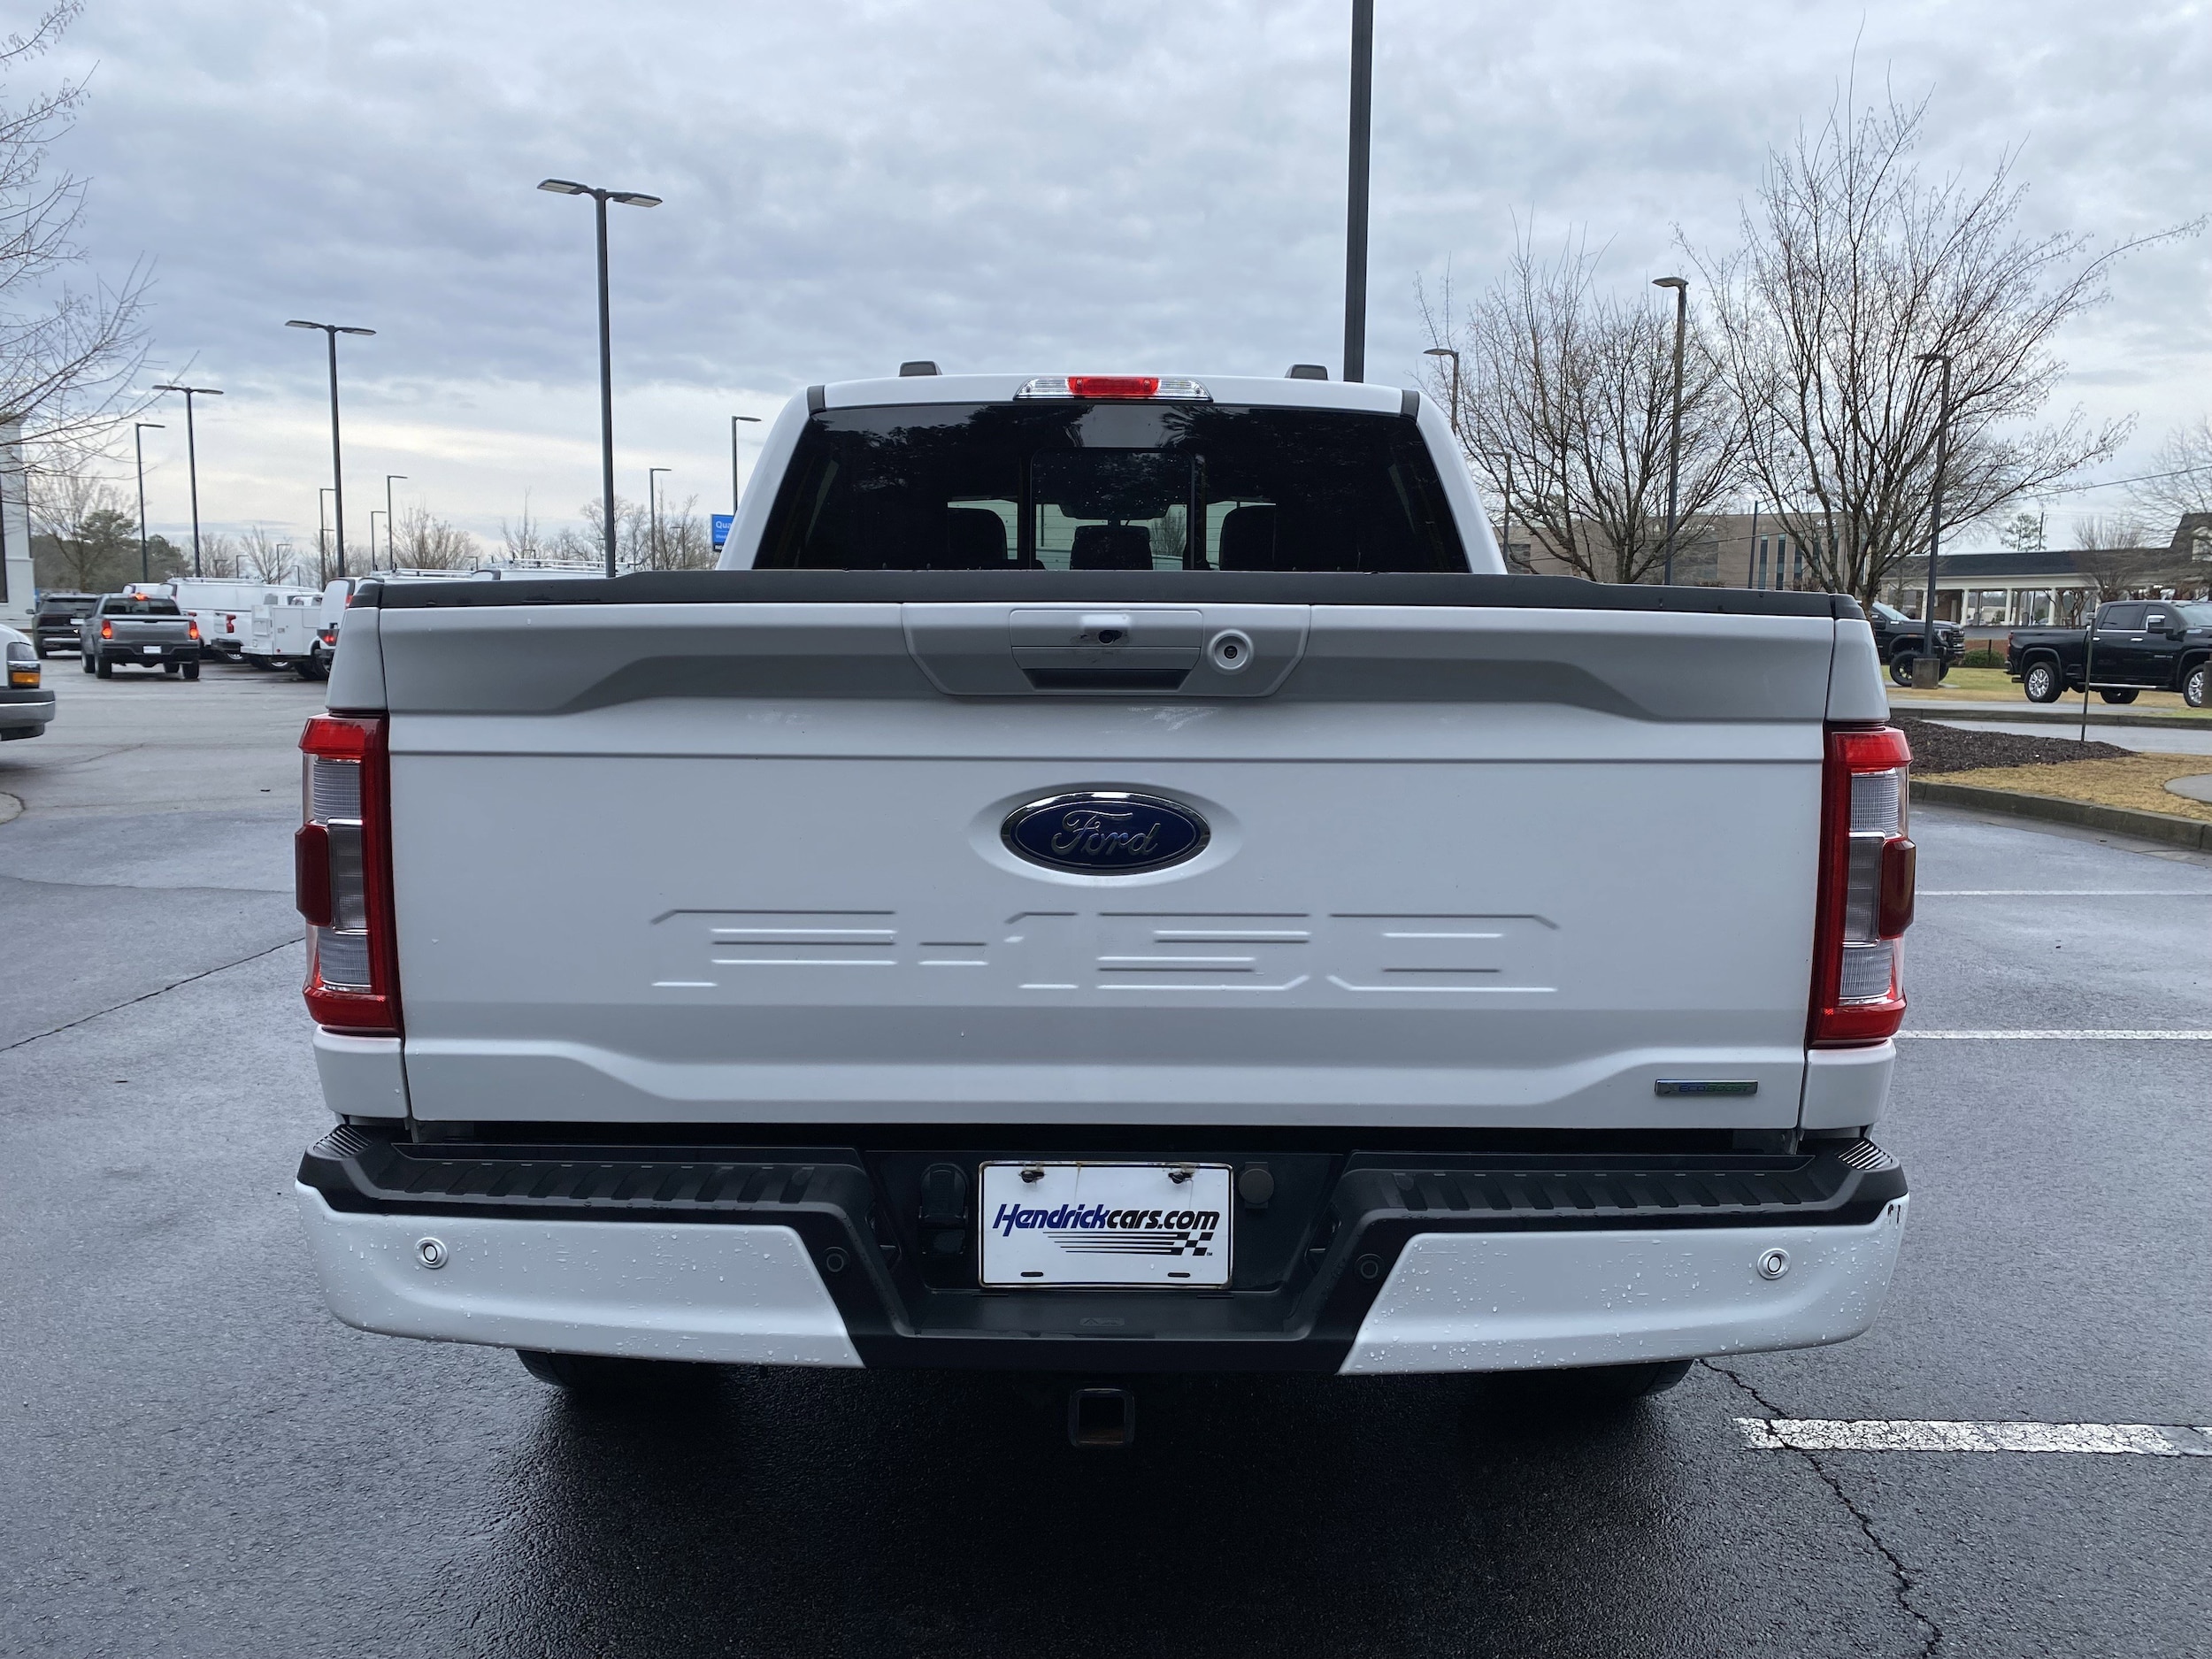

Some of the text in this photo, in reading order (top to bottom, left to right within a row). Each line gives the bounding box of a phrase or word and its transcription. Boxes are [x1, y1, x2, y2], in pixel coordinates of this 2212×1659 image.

[1050, 809, 1161, 856] Ford
[649, 909, 1560, 995] F-150
[992, 1203, 1220, 1237] Hendrickcars.com
